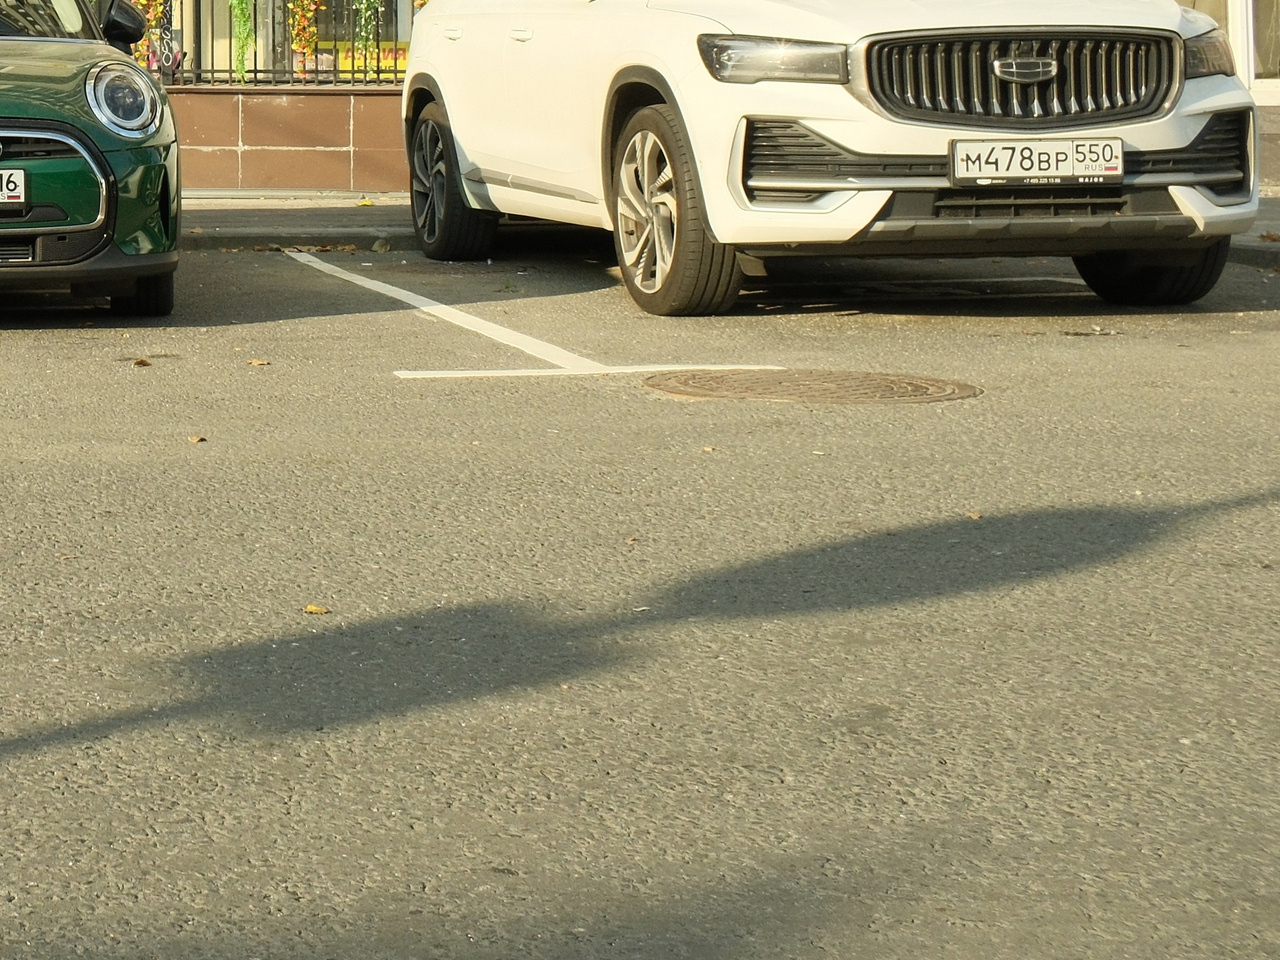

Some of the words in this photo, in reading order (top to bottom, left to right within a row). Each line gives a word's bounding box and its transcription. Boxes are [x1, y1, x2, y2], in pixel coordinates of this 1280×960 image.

[965, 146, 1068, 172] М478ВР
[1075, 143, 1114, 163] 550
[1084, 164, 1104, 172] RUS
